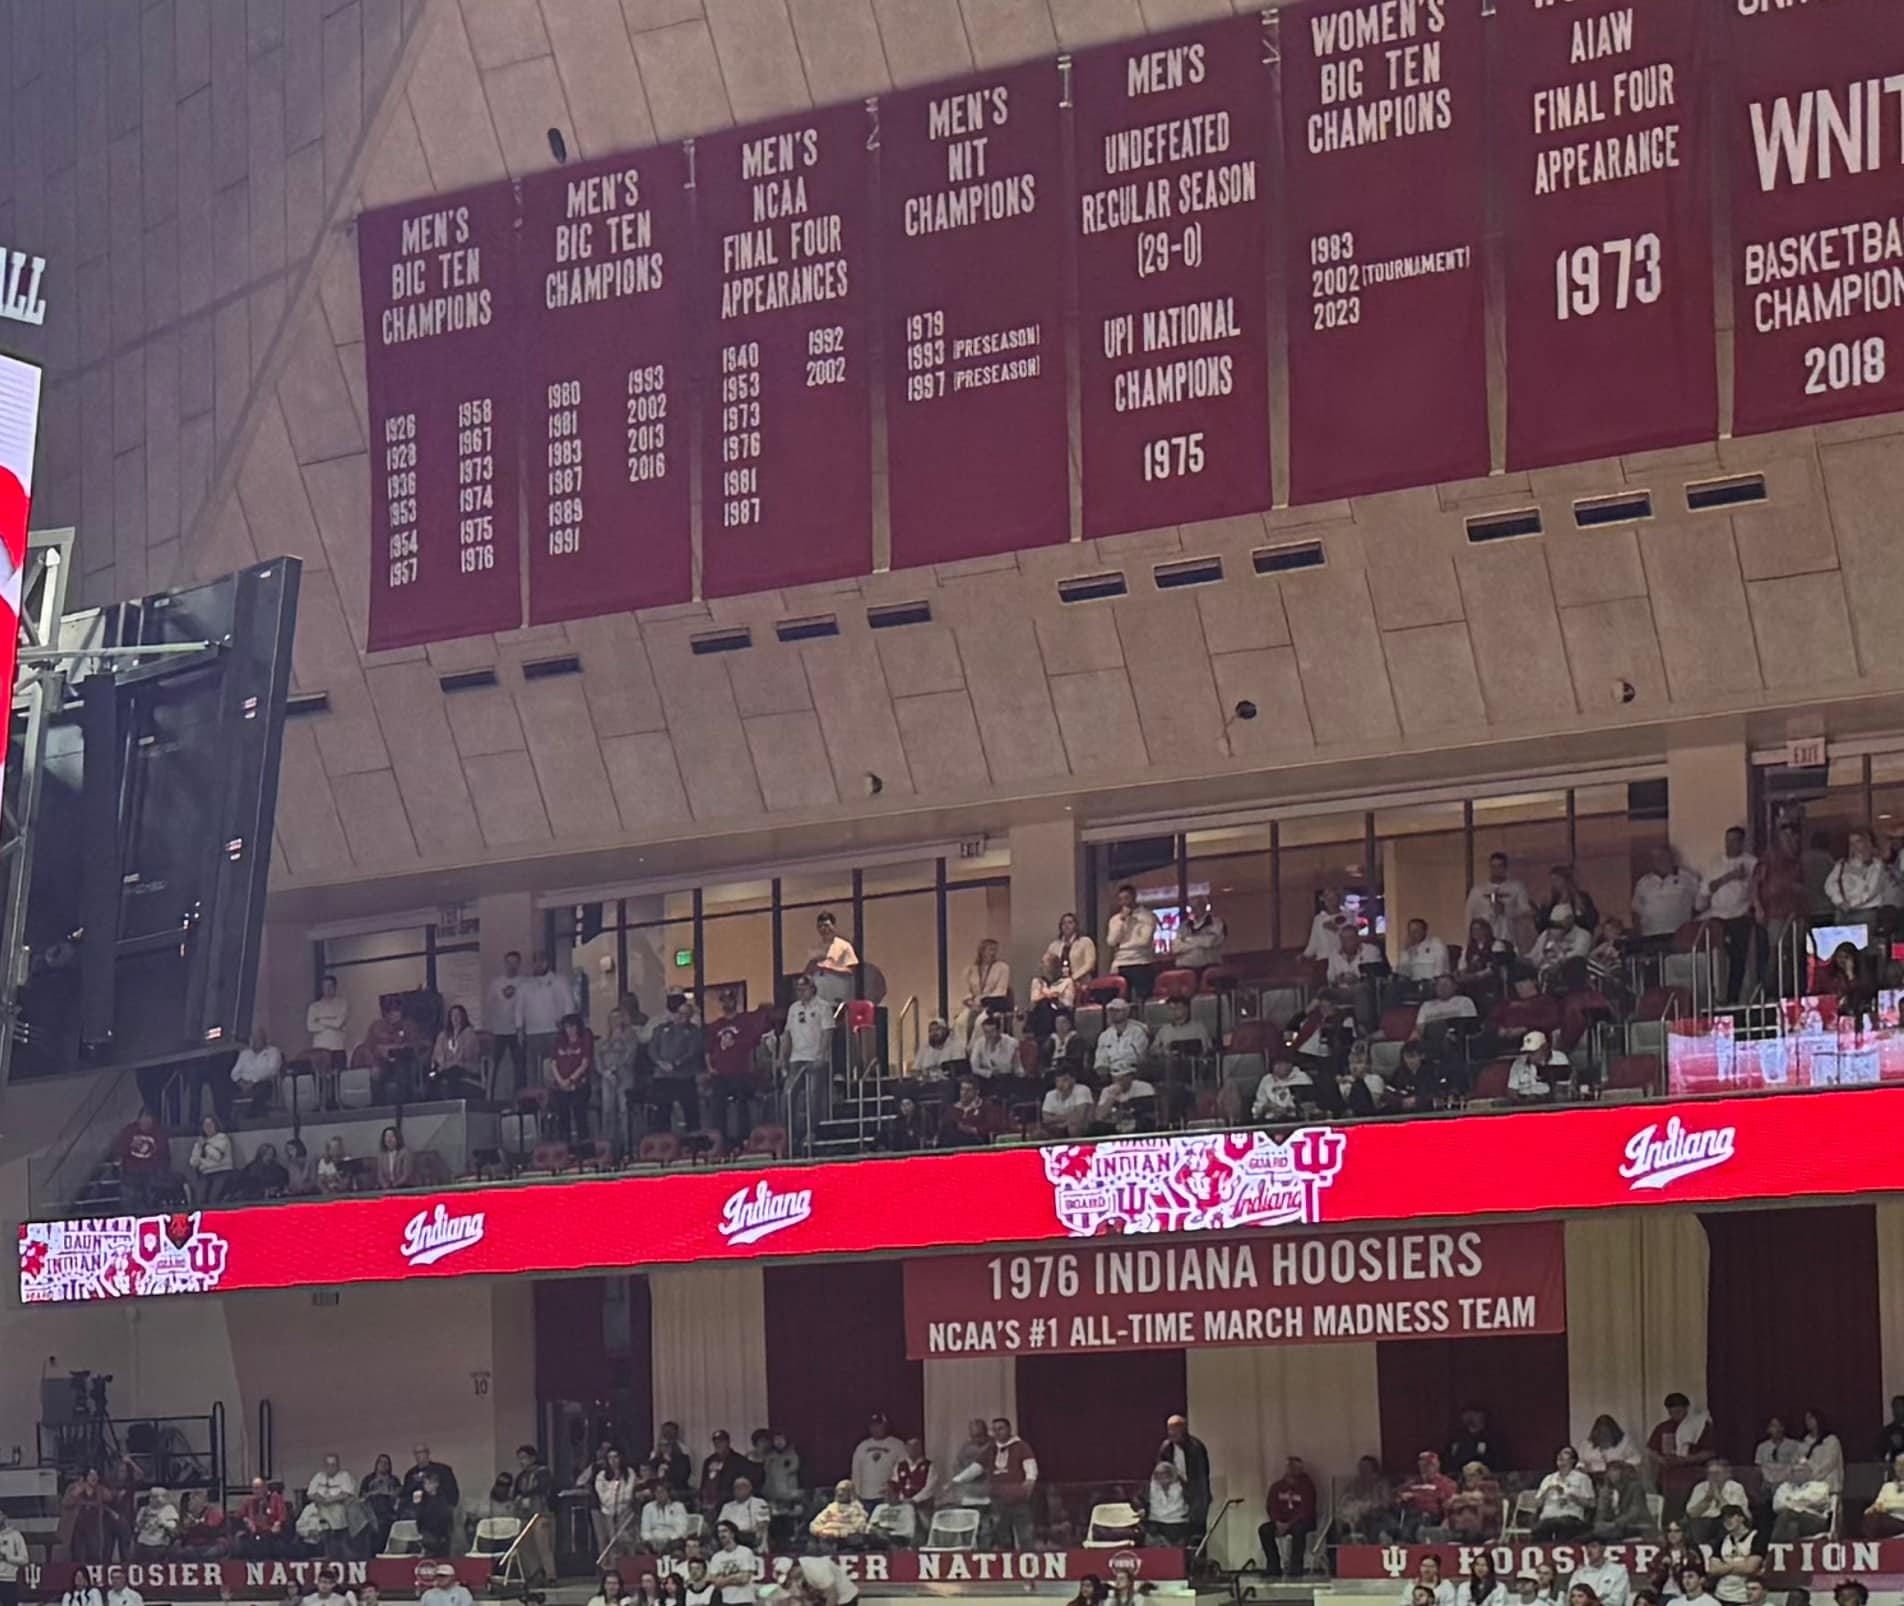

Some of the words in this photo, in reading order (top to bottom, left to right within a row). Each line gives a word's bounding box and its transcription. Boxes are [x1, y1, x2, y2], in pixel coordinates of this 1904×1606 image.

[1311, 0, 1445, 57] WOMEN'S
[1570, 8, 1634, 64] AIAW
[1127, 44, 1206, 97] MEN'S
[1321, 62, 1363, 104] BIG
[1385, 42, 1441, 90] TEN
[929, 86, 1008, 140] MEN'S
[1534, 80, 1605, 134] FINAL
[1613, 63, 1675, 114] FOUR
[1308, 88, 1452, 154] CHAMPIONS
[1749, 73, 1904, 192] WNIT
[742, 129, 818, 179] MEN'S
[948, 138, 988, 183] NIT
[1105, 111, 1230, 174] UNDEFEATED
[1535, 125, 1680, 195] APPEARANCE
[567, 170, 639, 218] MEN'S
[754, 181, 808, 223] NCAA
[905, 175, 1035, 236] CHAMPIONS
[1082, 180, 1172, 235] REGULAR
[1178, 161, 1257, 215] SEASON
[401, 207, 470, 256] MEN'S
[606, 211, 652, 254] TEN
[724, 230, 779, 273] FINAL
[791, 216, 842, 259] FOUR
[1138, 222, 1202, 278] (29-0)
[1311, 232, 1353, 265] 1983
[438, 248, 480, 286] TEN
[1745, 216, 1904, 286] BASKETBA
[545, 255, 663, 310] CHAMPIONS
[722, 260, 848, 319] APPEARANCES
[1312, 262, 1360, 298] 2002
[1556, 233, 1662, 321] 1973
[382, 289, 492, 345] CHAMPIONS
[907, 311, 944, 341] 1979
[1103, 316, 1134, 359] UPI
[1143, 297, 1240, 352] NATIONAL
[1313, 297, 1360, 331] 2023
[722, 342, 760, 371] 1940
[808, 326, 845, 356] 1992
[908, 341, 945, 370] 1993
[628, 365, 664, 394] 1993
[806, 356, 846, 387] 2002
[1115, 355, 1233, 412] CHAMPIONS
[1804, 337, 1885, 395] 2018
[548, 381, 580, 408] 1980
[722, 372, 760, 402] 1953
[908, 371, 945, 401] 1997
[386, 414, 417, 441] 1926
[459, 399, 492, 426] 1958
[549, 411, 578, 438] 1981
[628, 394, 667, 424] 2002
[723, 402, 761, 432] 1973
[459, 427, 492, 456] 1967
[549, 439, 582, 468] 1983
[628, 424, 665, 454] 2013
[723, 432, 761, 462] 1976
[1143, 433, 1205, 482] 1975
[460, 456, 493, 484] 1973
[549, 467, 583, 496] 1987
[629, 453, 666, 482] 2016
[724, 467, 757, 497] 1981
[389, 499, 418, 527] 1953
[460, 484, 493, 513] 1974
[549, 498, 583, 527] 1989
[724, 497, 761, 527] 1987
[390, 529, 418, 558] 1954
[461, 516, 493, 545] 1975
[550, 528, 579, 556] 1991
[390, 558, 418, 588] 1957
[461, 545, 494, 573] 1976
[1619, 1117, 1736, 1190] Indiana
[718, 1181, 812, 1246] Indiana
[400, 1204, 485, 1266] Indiana
[988, 1254, 1080, 1301] 1976
[1095, 1243, 1258, 1297] INDIANA
[1272, 1231, 1483, 1288] HOOSIERS
[928, 1317, 1020, 1354] NCAA'S
[1028, 1316, 1059, 1350] #1
[1070, 1311, 1195, 1347] ALL-TIME
[1202, 1305, 1303, 1342] MARCH
[1313, 1299, 1450, 1337] MADNESS
[1459, 1295, 1536, 1330] TEAM
[918, 1551, 1068, 1582] NATION
